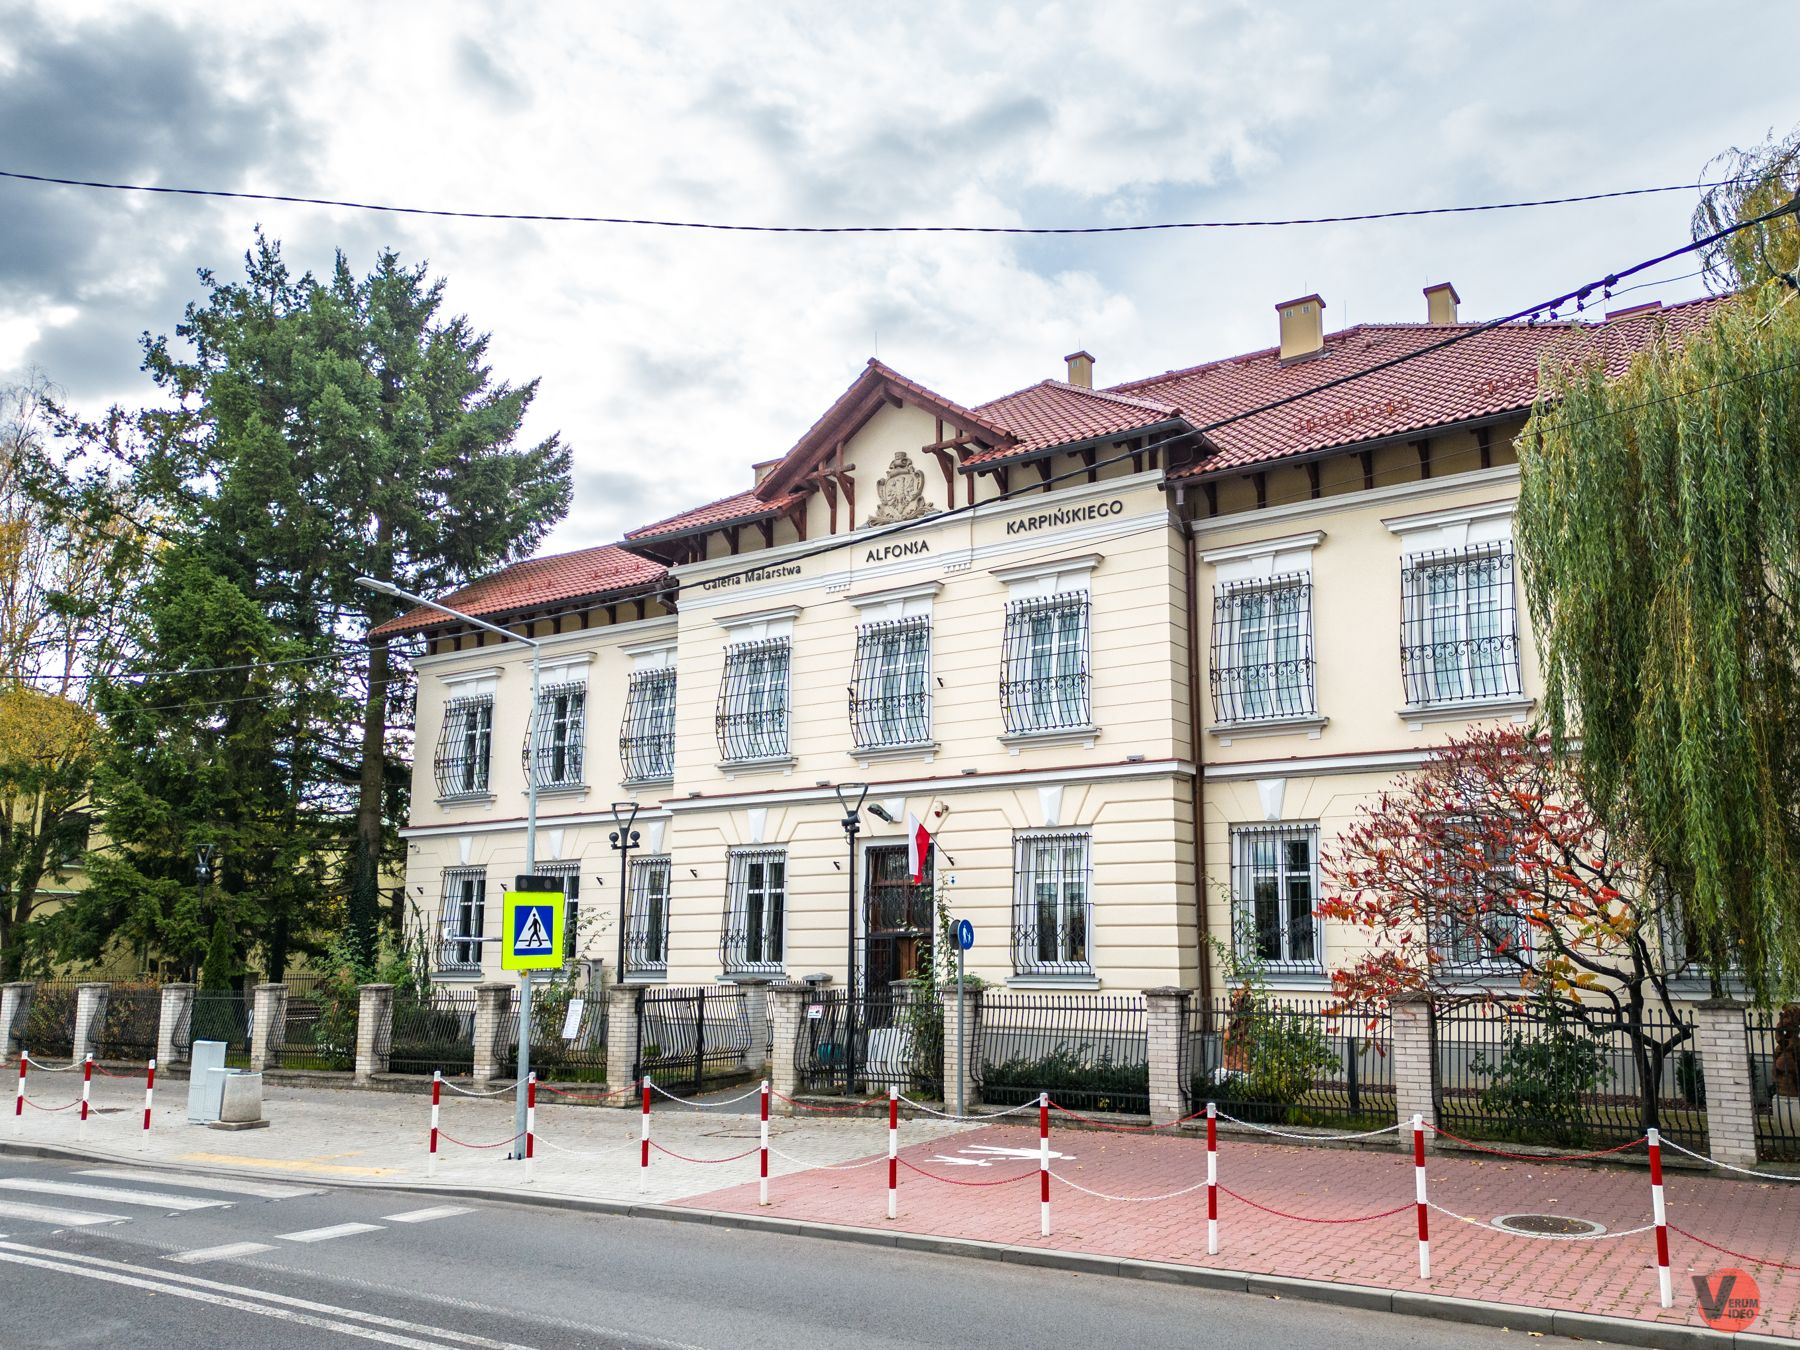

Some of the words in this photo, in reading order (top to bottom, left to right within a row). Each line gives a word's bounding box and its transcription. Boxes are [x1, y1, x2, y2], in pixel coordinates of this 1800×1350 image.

[865, 539, 930, 562] ALFONSA
[1006, 500, 1122, 534] KARPIŃSKIEGO
[744, 565, 801, 583] Malarstwa
